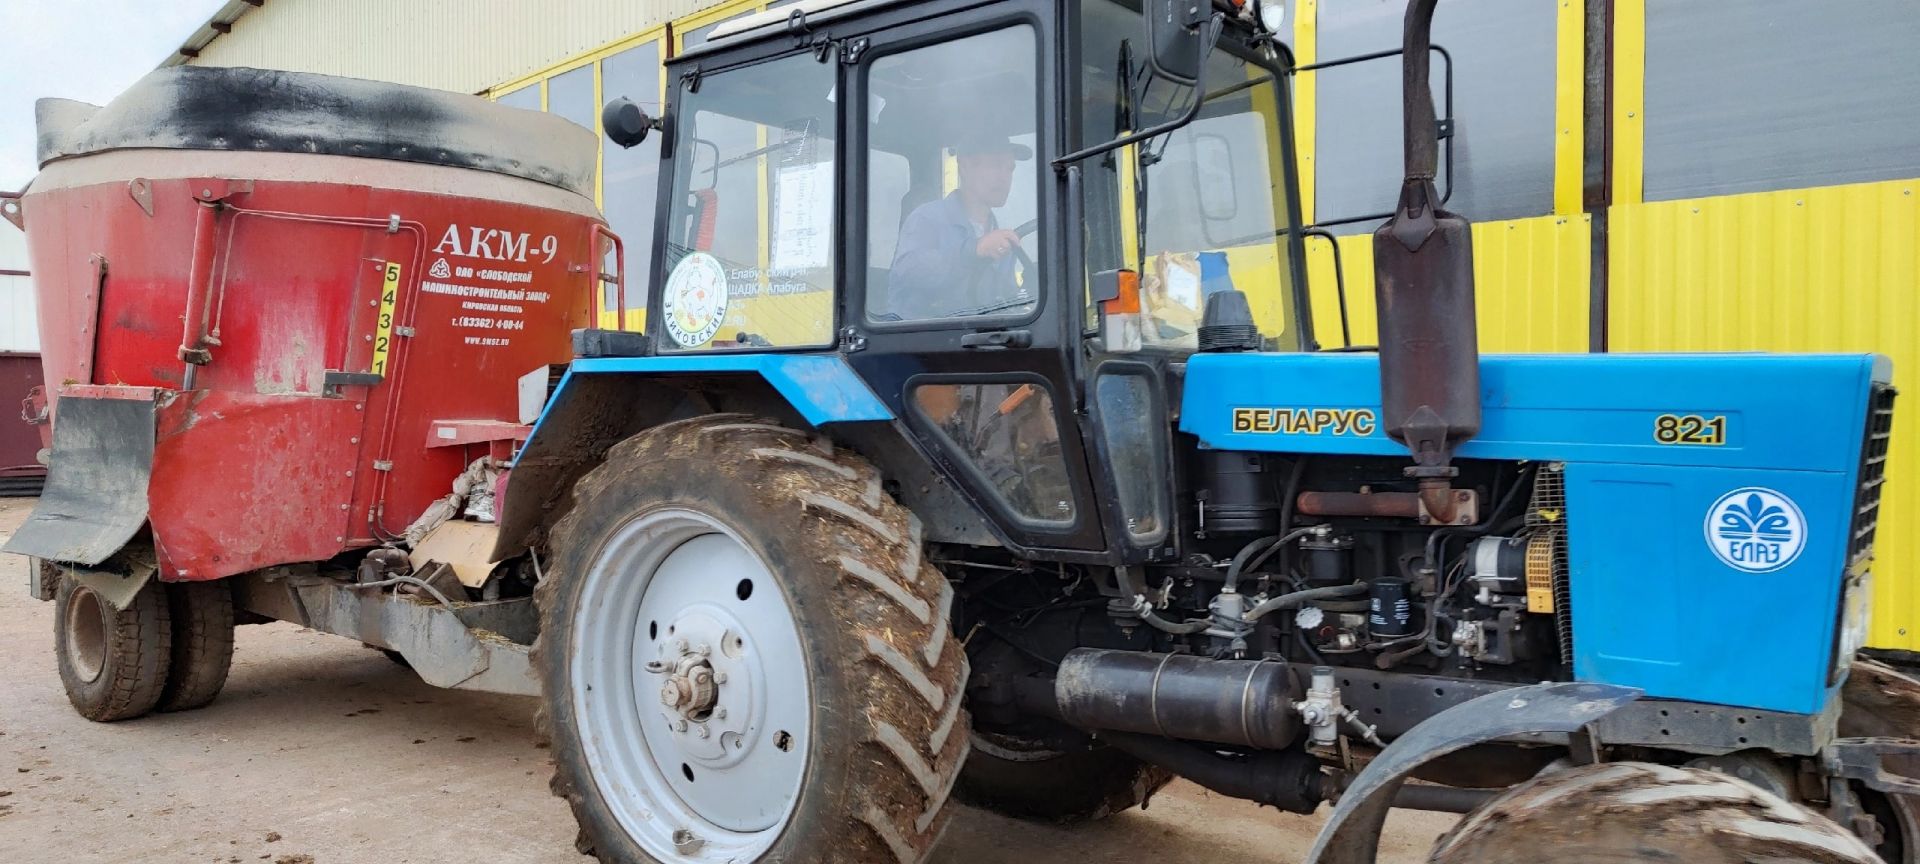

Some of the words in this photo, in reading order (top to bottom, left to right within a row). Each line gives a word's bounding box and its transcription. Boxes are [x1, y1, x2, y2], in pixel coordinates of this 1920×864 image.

[432, 223, 558, 265] АКМ-9
[386, 266, 398, 282] 5
[455, 266, 474, 278] ОАО
[383, 290, 394, 306] 4
[421, 281, 526, 301] МАШИНОСТРОИТЕЛЬНЫЙ
[379, 313, 391, 329] 3
[376, 337, 388, 353] 2
[375, 360, 384, 374] 1
[1233, 408, 1376, 436] БЕЛАРУС
[1653, 414, 1726, 445] 82.1
[1730, 541, 1780, 563] ЕЛАЗ
